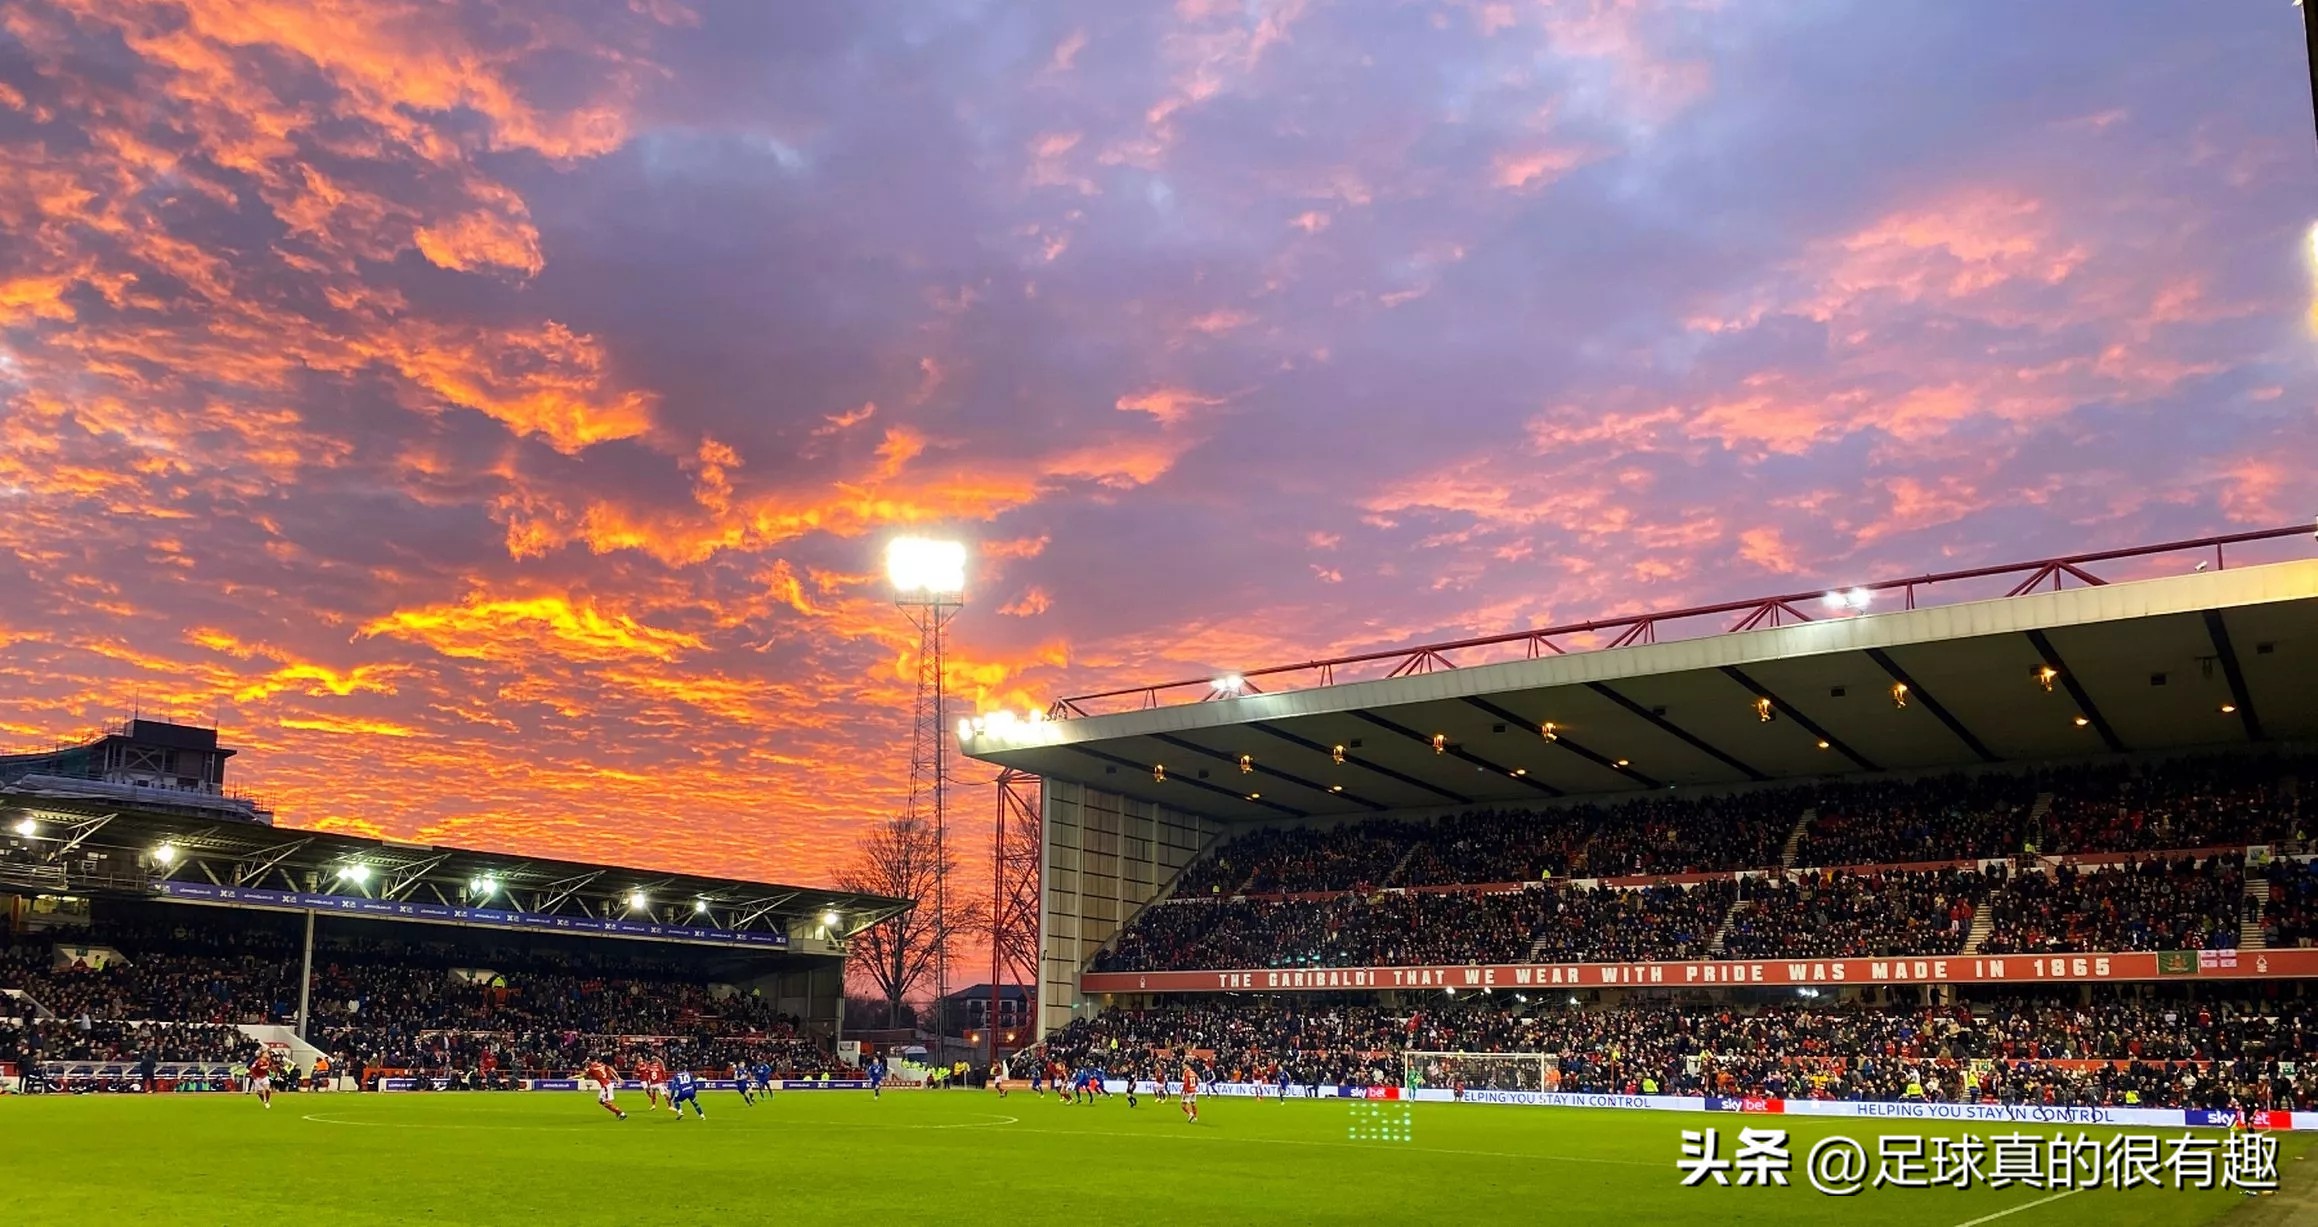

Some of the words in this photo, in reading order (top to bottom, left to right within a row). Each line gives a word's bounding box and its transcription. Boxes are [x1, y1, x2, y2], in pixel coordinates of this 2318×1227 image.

[1219, 973, 1251, 989] THE
[1268, 971, 1375, 988] GARIBALDI
[1394, 969, 1445, 986] THAT
[1465, 969, 1494, 985] WE
[1515, 967, 1579, 984] WEAR
[1602, 966, 1663, 983] WITH
[1686, 965, 1763, 982] PRIDE
[1788, 963, 1845, 981] WAS
[1871, 961, 1948, 979] MADE
[1975, 959, 2005, 978] IN
[2034, 958, 2110, 977] 1865
[1236, 1085, 1246, 1094] IN
[1350, 1087, 1367, 1099] sky
[1370, 1087, 1387, 1098] bet
[1464, 1091, 1506, 1102] ELPING
[1511, 1093, 1535, 1104] YOU
[1573, 1095, 1585, 1106] IN
[1590, 1095, 1651, 1107] CONTROL
[1721, 1098, 1742, 1112] sky
[1746, 1099, 1768, 1111] bet
[1857, 1104, 1923, 1117] HELPING
[1928, 1105, 1960, 1118] YOU
[1967, 1106, 2004, 1119] STAY
[2033, 1108, 2114, 1122] CONTROL
[2208, 1110, 2236, 1127] sky
